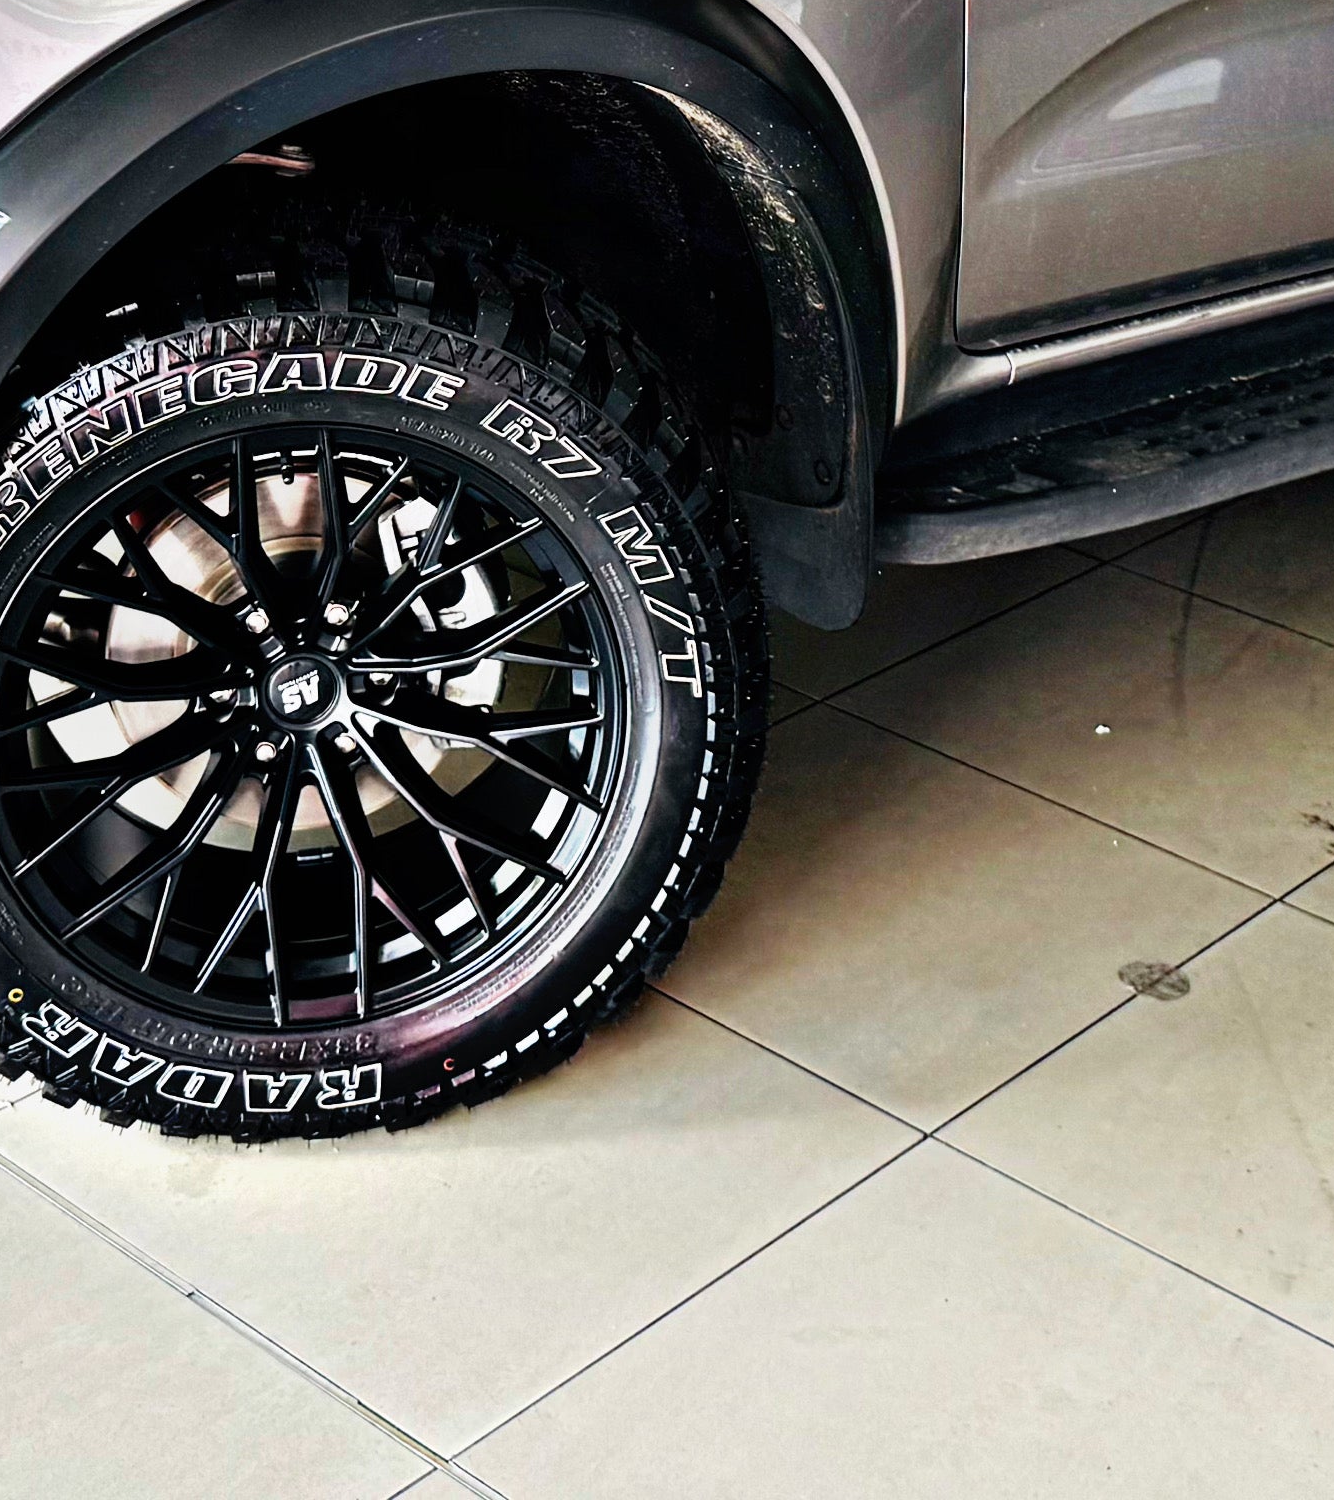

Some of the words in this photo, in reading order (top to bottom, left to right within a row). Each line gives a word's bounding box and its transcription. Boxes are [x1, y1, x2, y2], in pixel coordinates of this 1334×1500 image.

[479, 397, 604, 480] R7
[595, 504, 704, 700] M/T
[21, 1000, 383, 1112] RADAR
